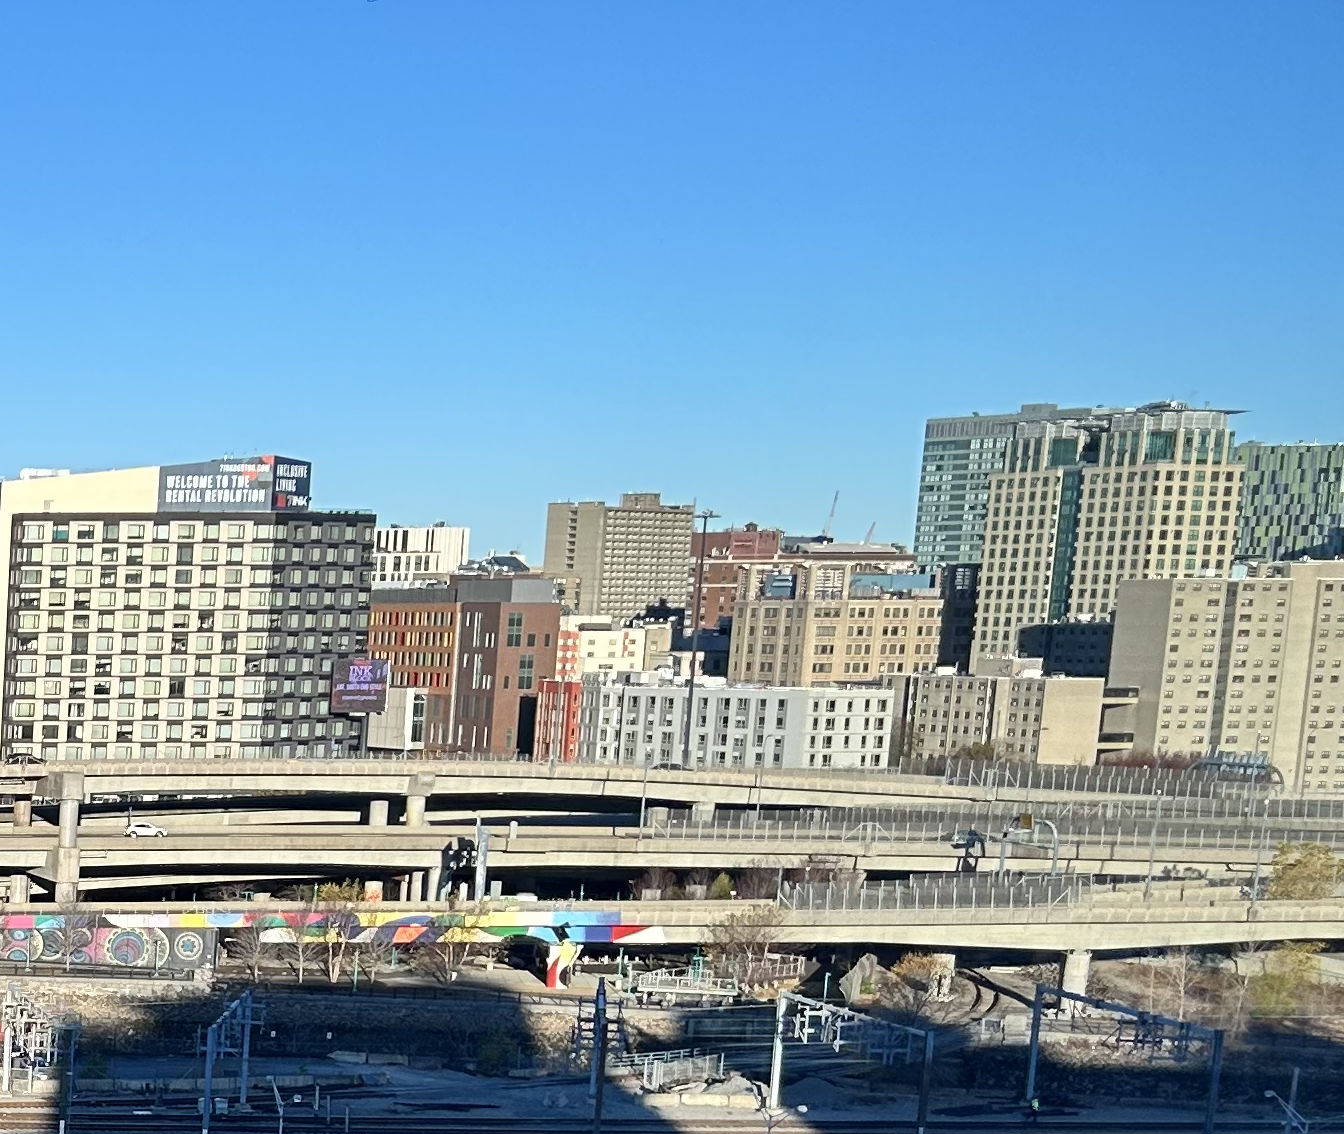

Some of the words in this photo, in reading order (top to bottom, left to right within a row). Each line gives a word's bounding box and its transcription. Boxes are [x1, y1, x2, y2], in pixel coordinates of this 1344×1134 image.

[166, 475, 213, 488] WELCOME
[216, 475, 229, 488] TO
[232, 475, 250, 488] THE
[275, 479, 297, 492] LIVING
[165, 489, 202, 503] RENTAL
[204, 489, 266, 503] REVOLUTION
[349, 665, 373, 676] INK
